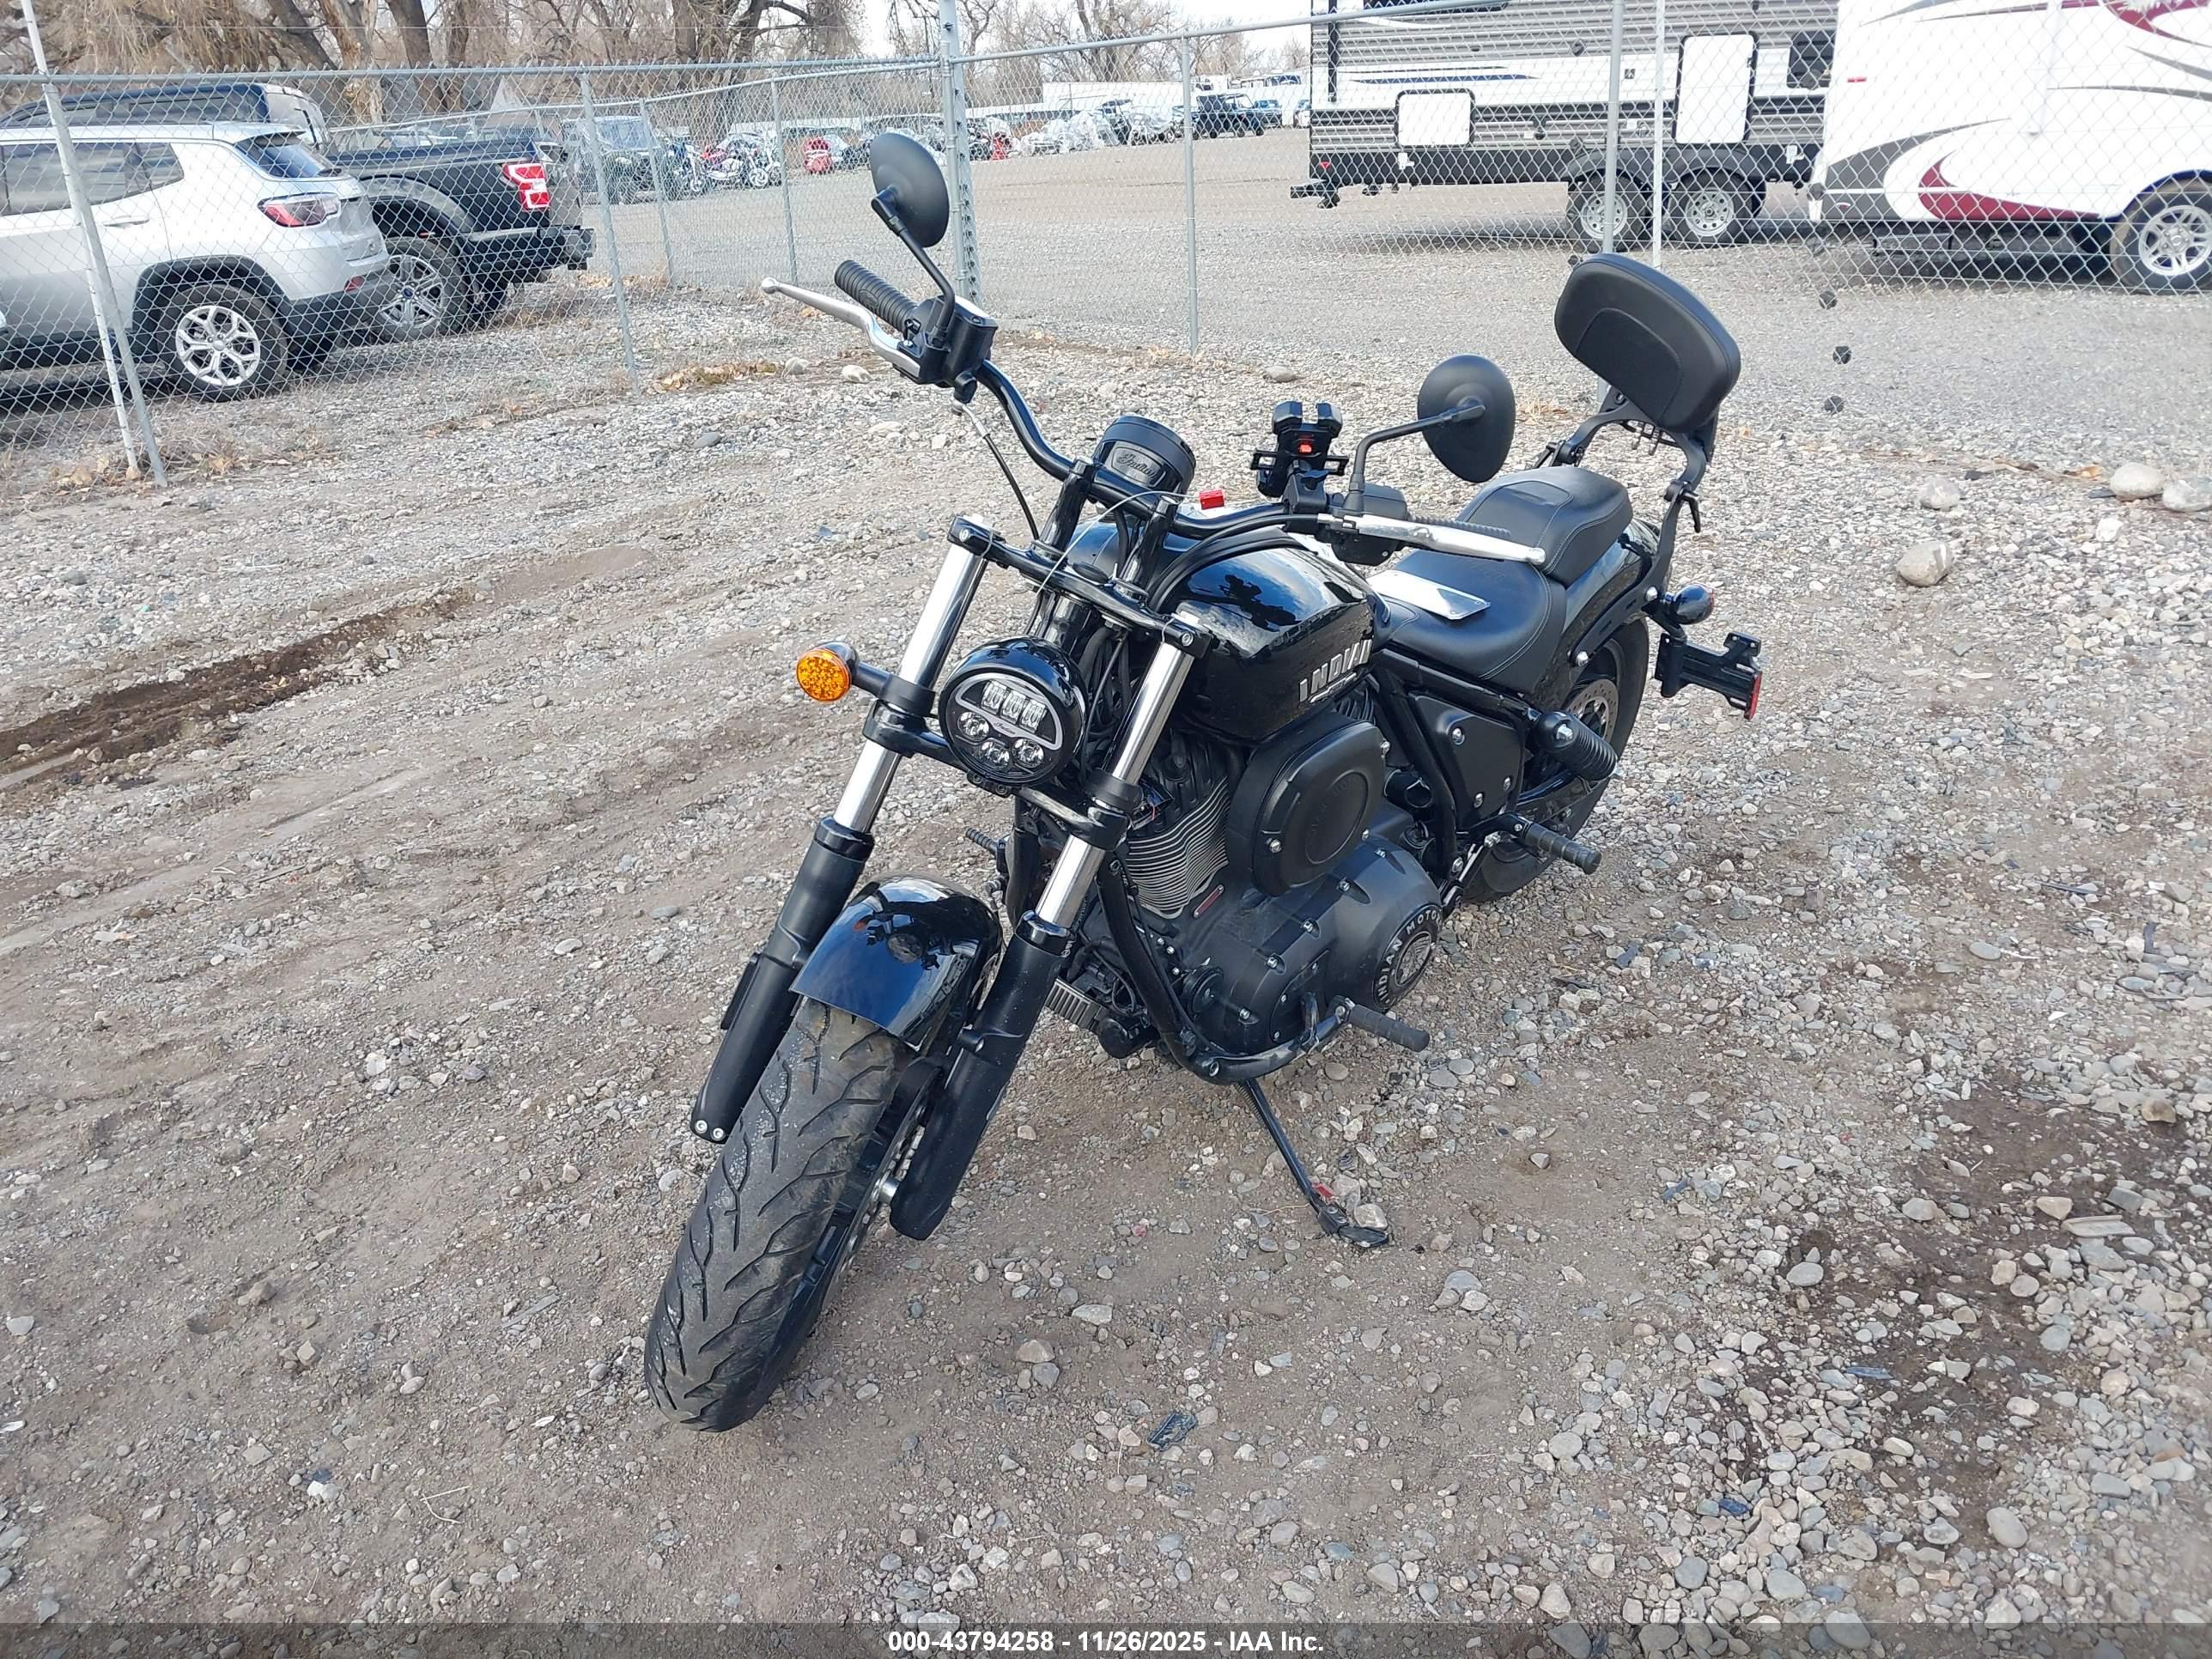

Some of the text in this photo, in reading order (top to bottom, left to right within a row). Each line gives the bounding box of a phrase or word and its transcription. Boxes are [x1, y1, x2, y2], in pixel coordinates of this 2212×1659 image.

[1116, 453, 1157, 477] Indian
[1299, 639, 1372, 702] INDIAN
[1377, 938, 1403, 1000] INDIAN
